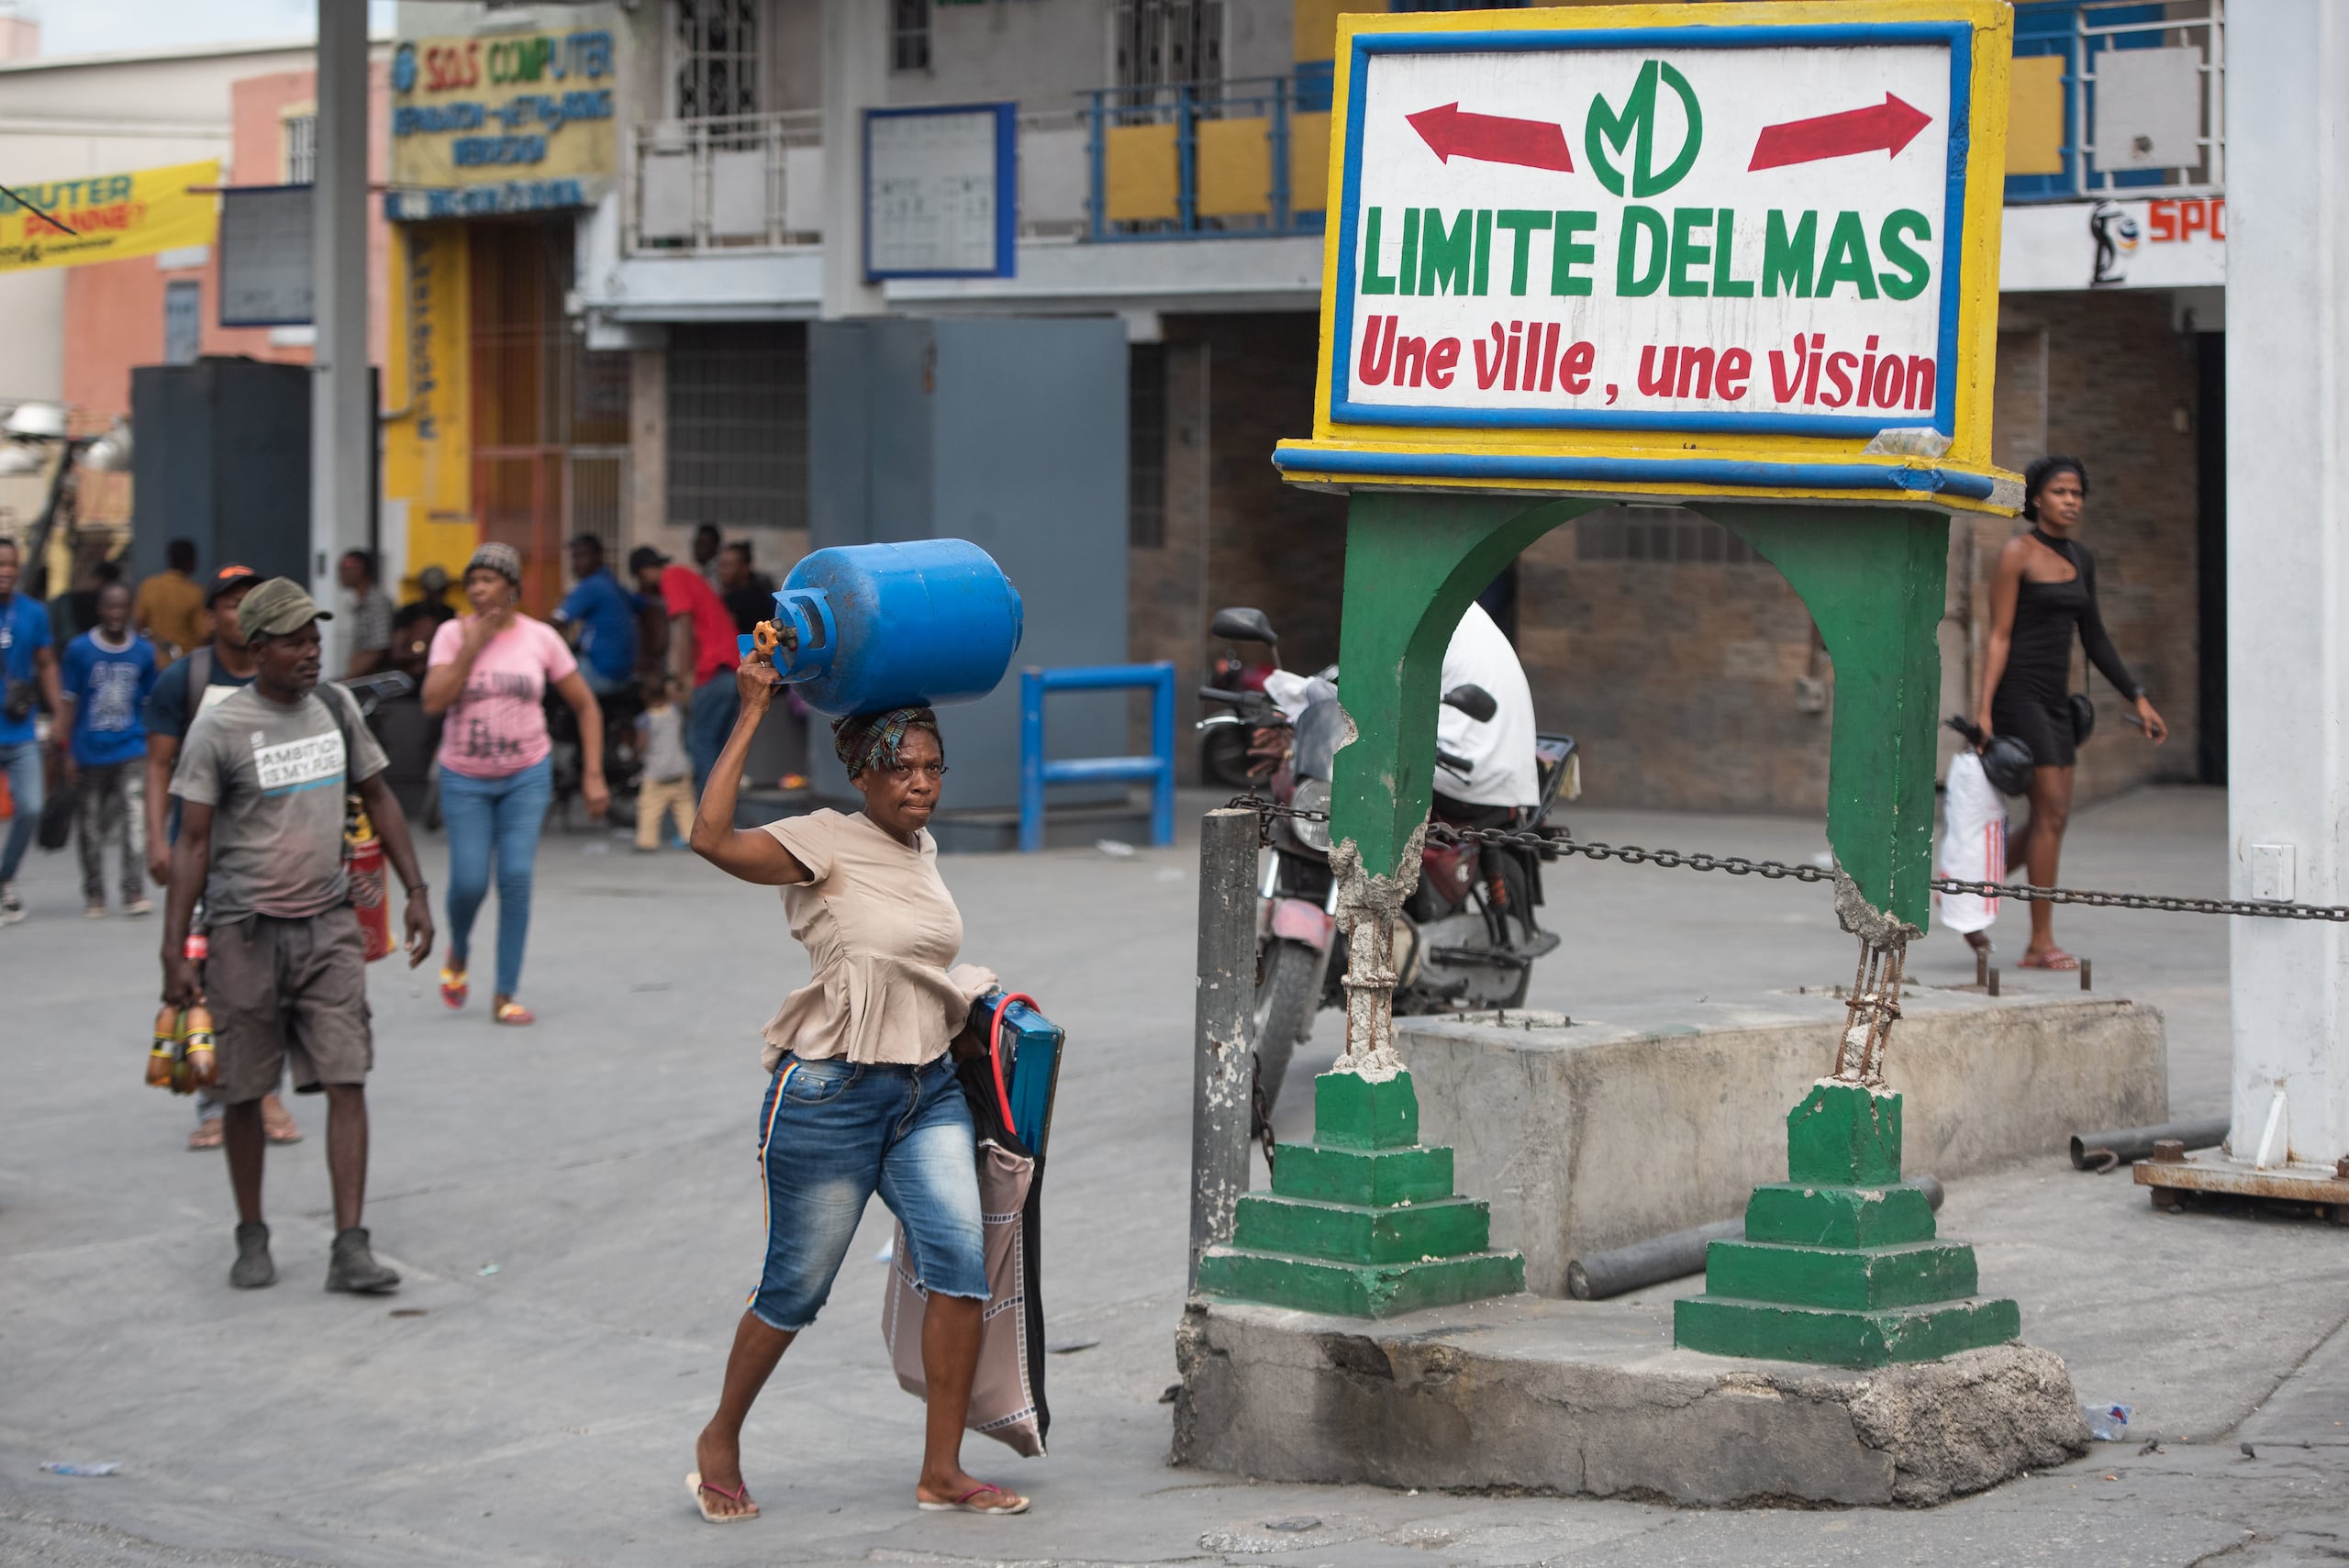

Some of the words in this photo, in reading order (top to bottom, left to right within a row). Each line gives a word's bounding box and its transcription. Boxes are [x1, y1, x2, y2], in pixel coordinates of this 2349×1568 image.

[1361, 206, 1597, 296] LIMITE
[1616, 205, 1932, 301] DELMAS
[1358, 315, 1459, 389] Une
[1636, 345, 1752, 401] une
[1767, 331, 1936, 411] vision
